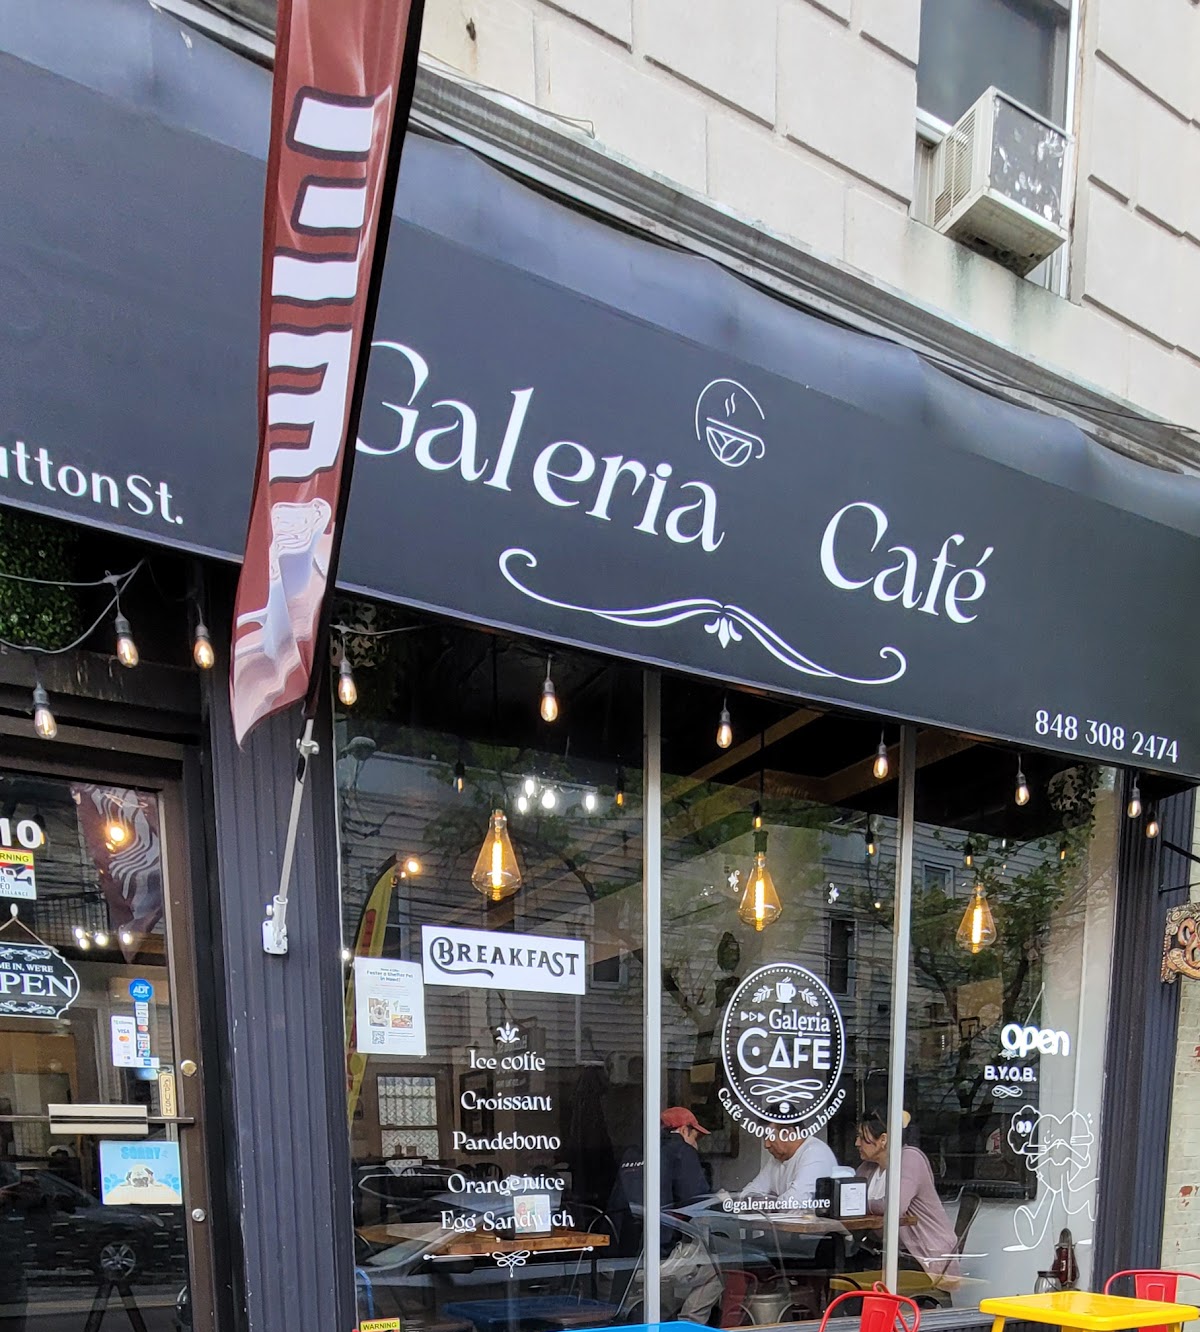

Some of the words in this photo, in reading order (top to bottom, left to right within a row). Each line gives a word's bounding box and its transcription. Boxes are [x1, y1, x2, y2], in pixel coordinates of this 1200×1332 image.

[356, 341, 725, 553] Galeria
[820, 501, 994, 624] Café
[126, 474, 184, 525] St.
[1035, 709, 1078, 741] 848
[1085, 719, 1125, 750] 308
[1131, 731, 1178, 764] 2474
[429, 936, 580, 978] BREAKFAST
[133, 985, 150, 995] ADT
[769, 1009, 830, 1033] Galeria
[469, 1049, 497, 1071] Ice
[984, 1065, 1038, 1082] B.Y.O.B.
[460, 1090, 553, 1112] Croissant
[718, 1087, 744, 1121] Café
[740, 1117, 776, 1142] 100%
[779, 1088, 847, 1142] Colombiano
[452, 1131, 561, 1150] Pandebono
[722, 1196, 831, 1213] @galeriacafe.store
[441, 1210, 477, 1233] Egg
[362, 1321, 397, 1331] WARNING
